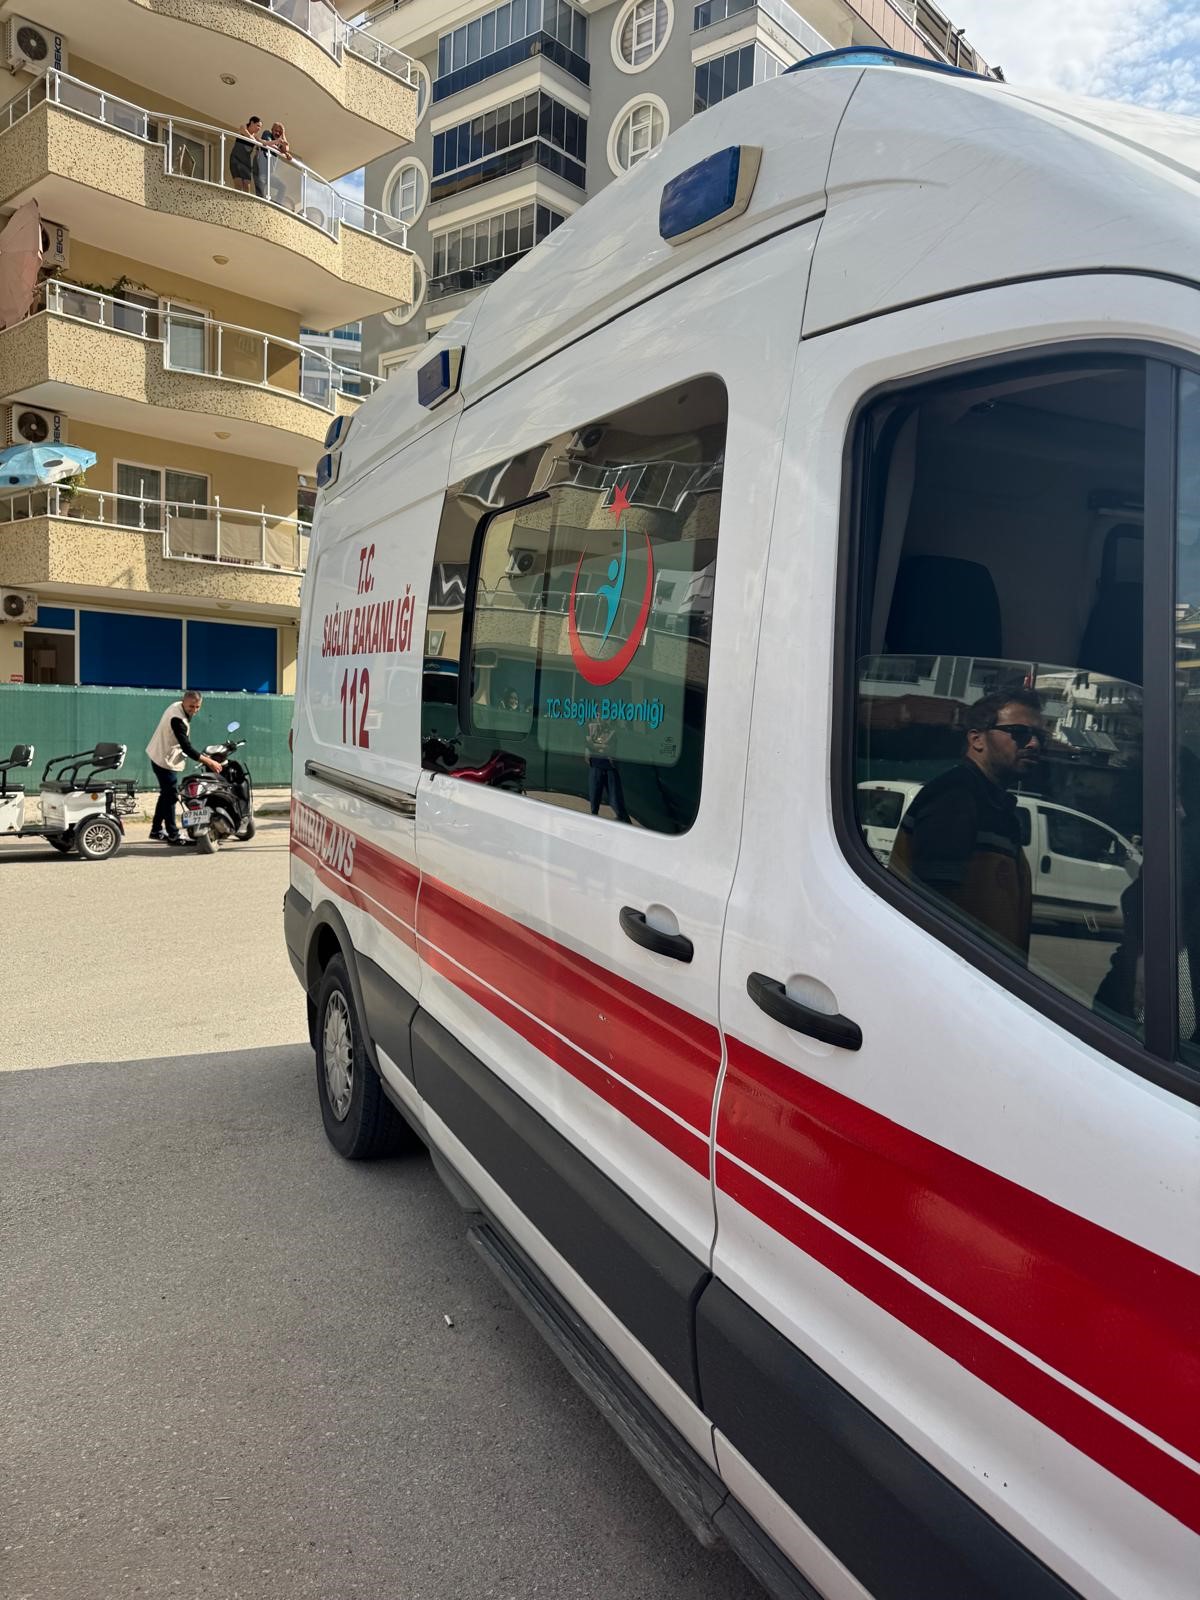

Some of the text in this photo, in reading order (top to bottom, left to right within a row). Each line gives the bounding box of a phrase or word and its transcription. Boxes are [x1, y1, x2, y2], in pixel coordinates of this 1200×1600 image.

[322, 584, 416, 658] SAĞLIK BAKANLIĞI
[340, 667, 370, 749] 112
[601, 697, 665, 729] Bakanlığı
[292, 801, 356, 877] AMBULANS
